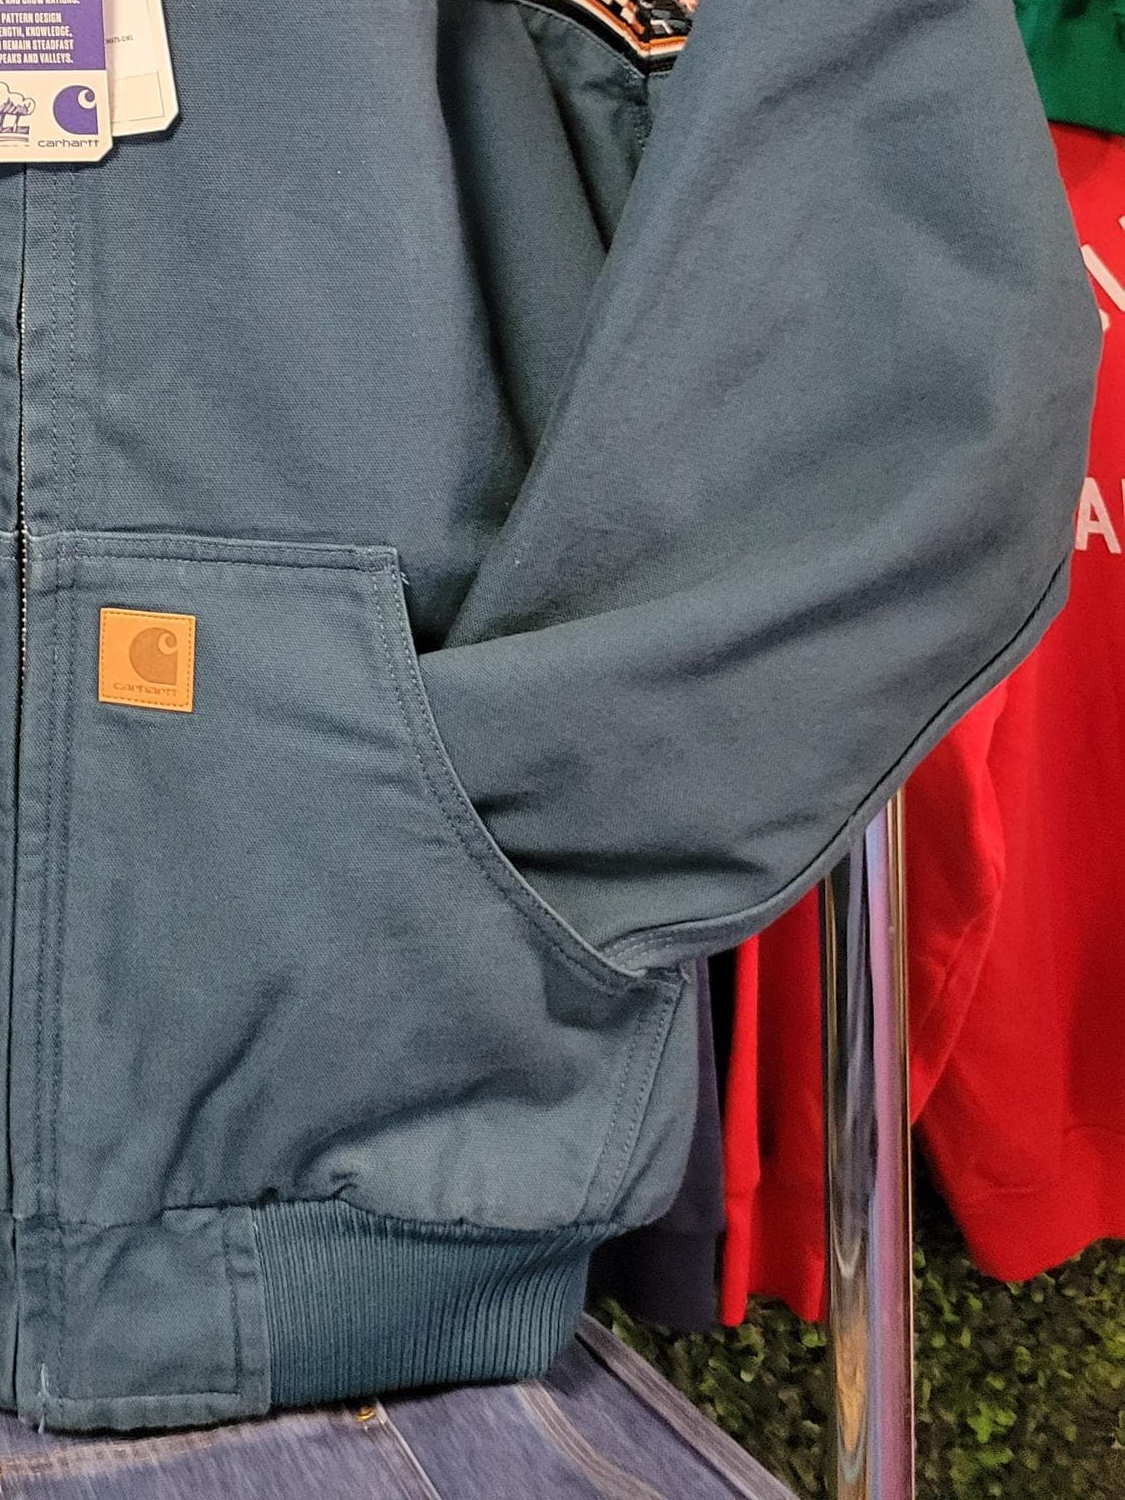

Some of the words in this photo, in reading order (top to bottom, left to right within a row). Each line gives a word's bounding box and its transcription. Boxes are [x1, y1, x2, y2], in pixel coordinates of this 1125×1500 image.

[2, 13, 33, 23] PATTERN
[35, 12, 62, 23] DESIGN
[2, 40, 31, 50] REMAIN
[32, 40, 74, 50] STEADFAST
[24, 53, 38, 64] AND
[40, 53, 73, 64] VALLEYS.
[37, 139, 100, 148] carhartt
